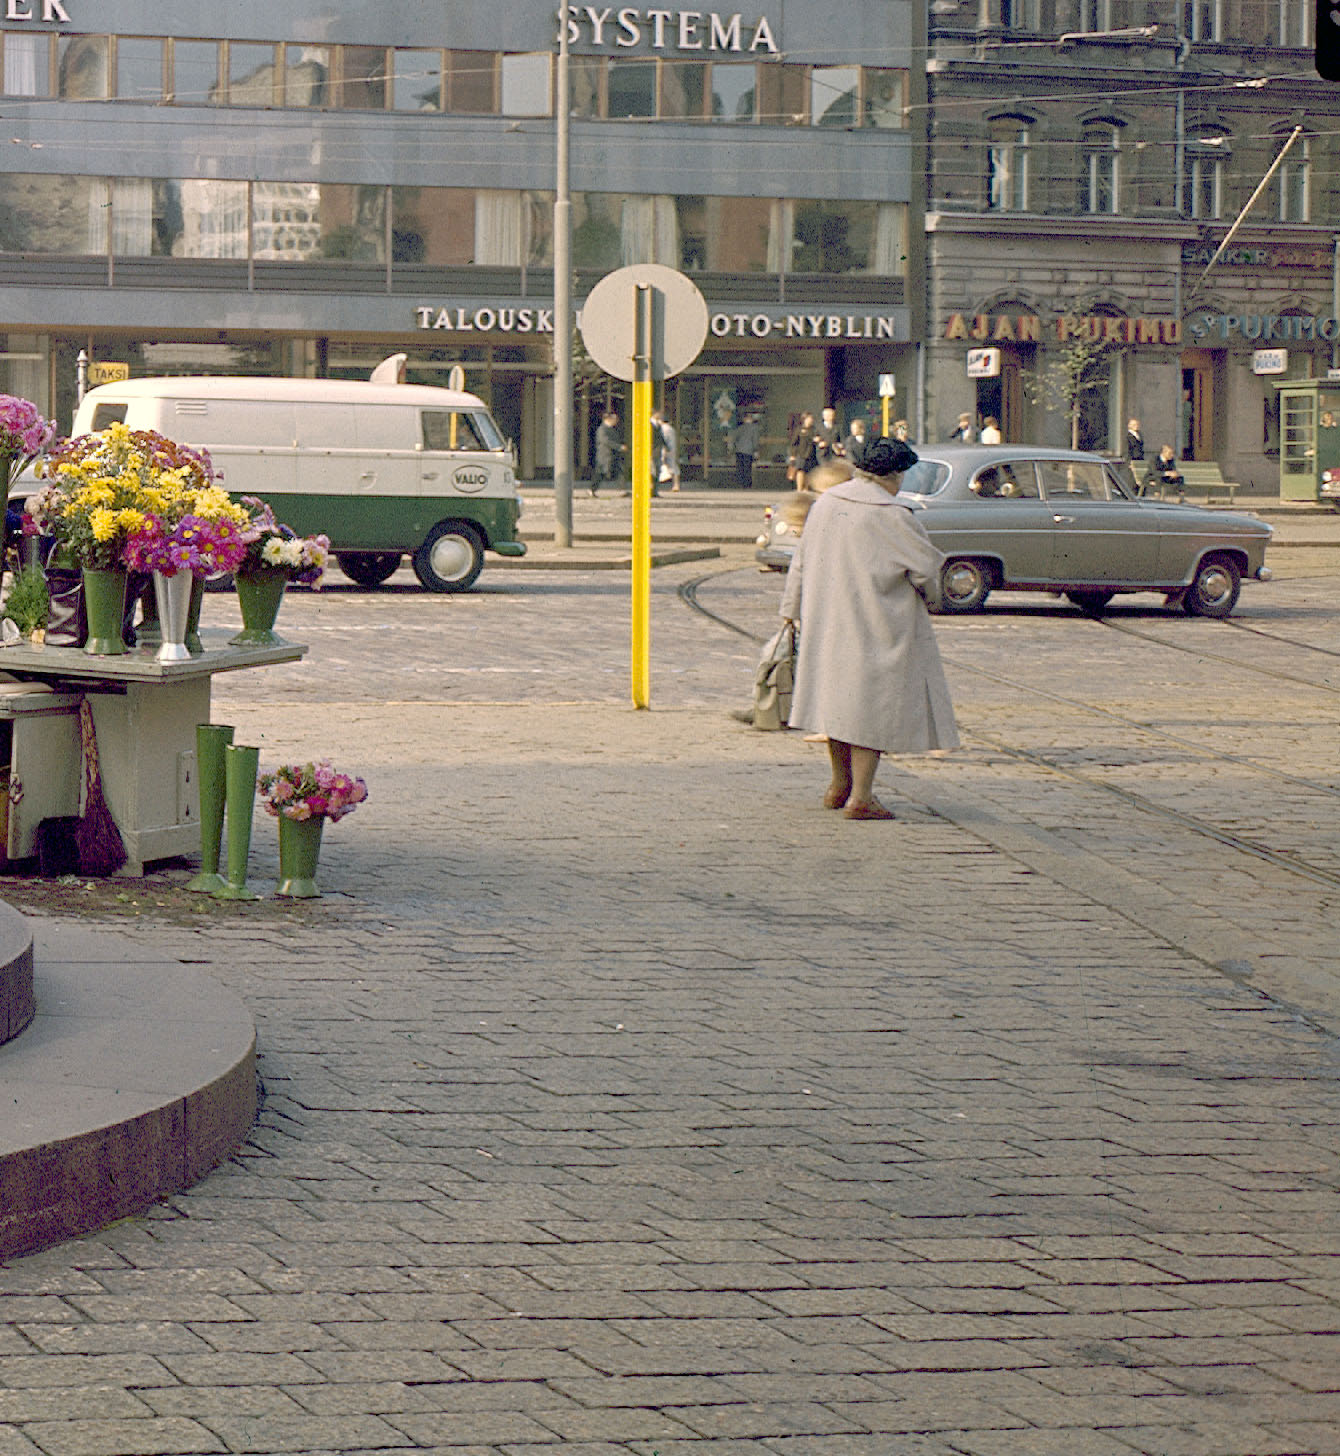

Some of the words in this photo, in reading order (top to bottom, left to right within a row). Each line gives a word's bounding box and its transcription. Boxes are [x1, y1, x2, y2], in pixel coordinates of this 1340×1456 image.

[556, 5, 779, 53] SYSTEMA
[711, 313, 896, 339] OTO-NYBLIN
[944, 312, 1041, 342] AJAN
[1057, 315, 1183, 344] PUKIMO
[1220, 314, 1340, 341] PUKIMO
[95, 368, 127, 380] TAKSI
[454, 473, 487, 485] VALIO
